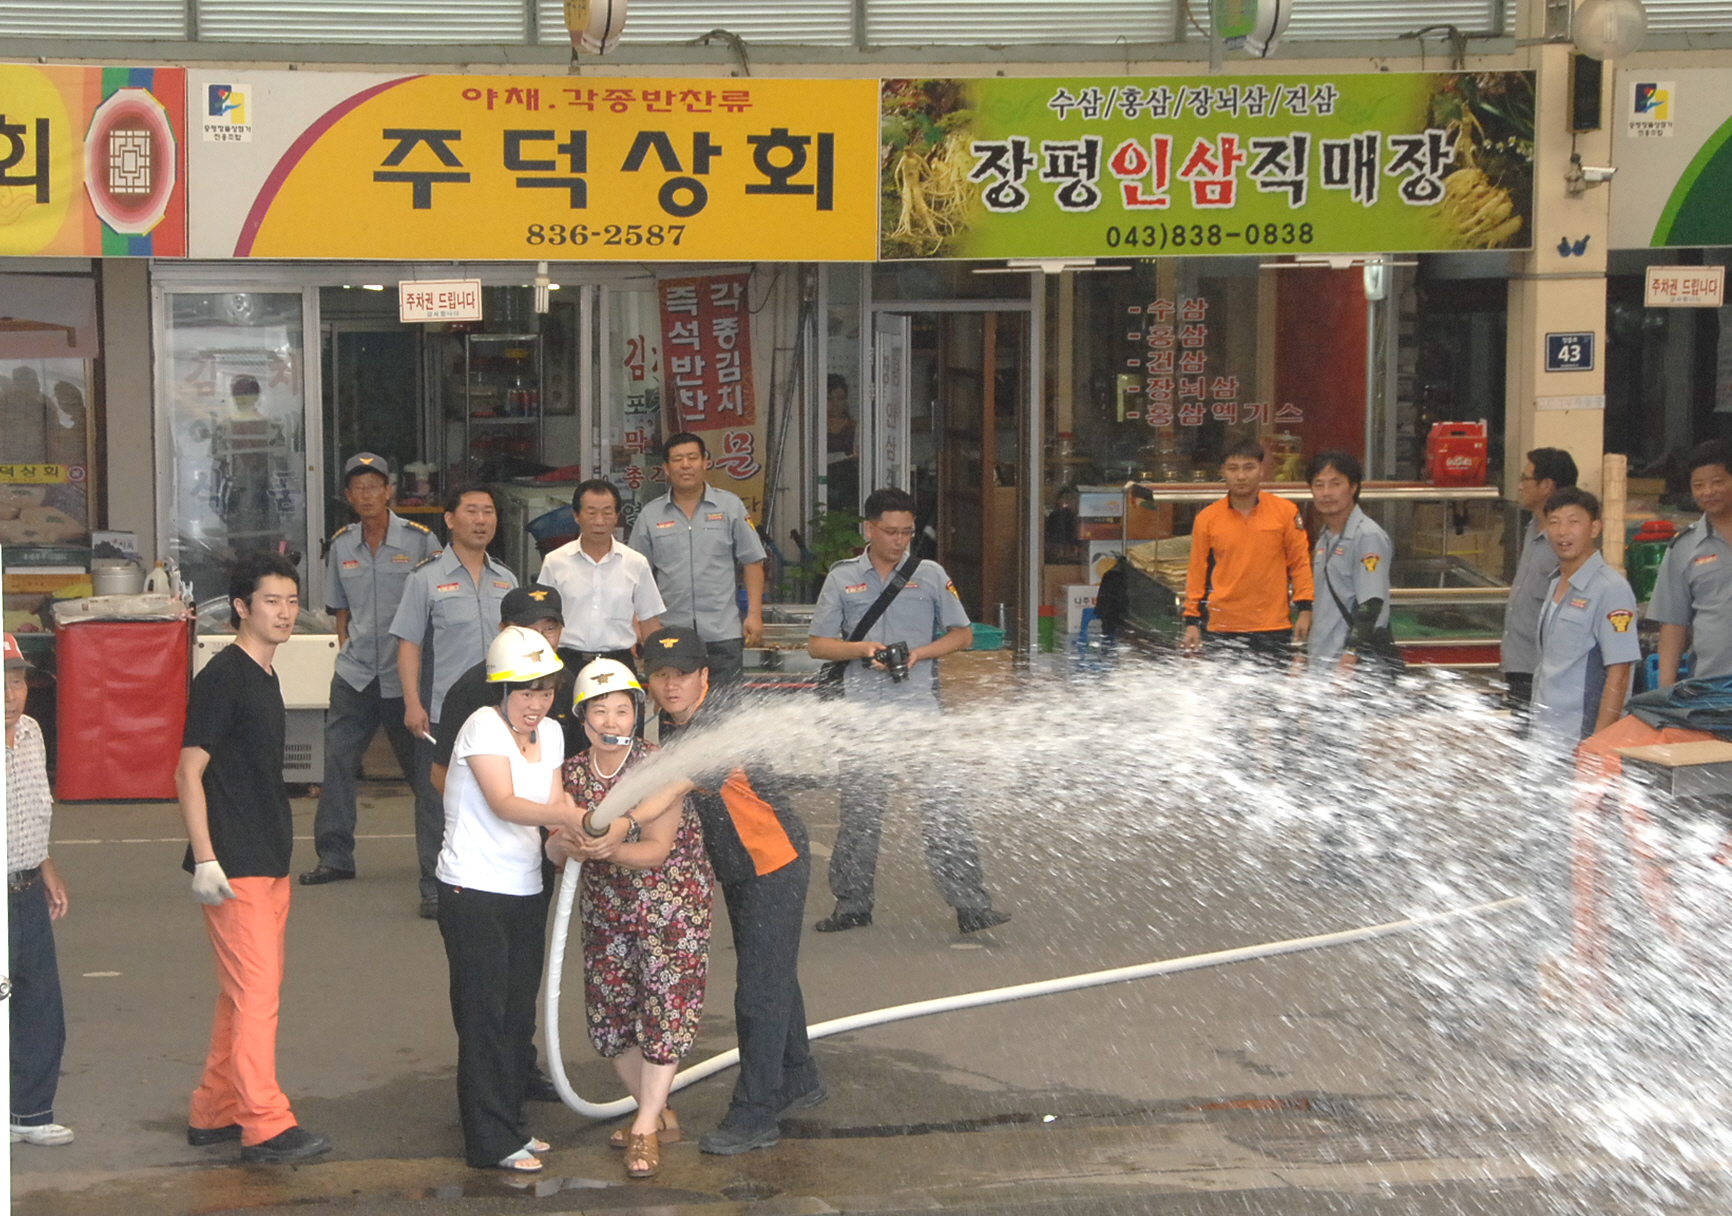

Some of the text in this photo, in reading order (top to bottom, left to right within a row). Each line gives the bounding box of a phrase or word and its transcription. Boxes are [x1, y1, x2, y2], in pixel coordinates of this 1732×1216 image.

[373, 127, 835, 218] 주덕상회
[526, 224, 686, 246] 836-2587
[1106, 223, 1314, 250] 043)838-0838
[1651, 278, 1718, 296] 주차권 드립니다
[406, 290, 476, 311] 주차권 드립니다
[1557, 345, 1582, 362] 43
